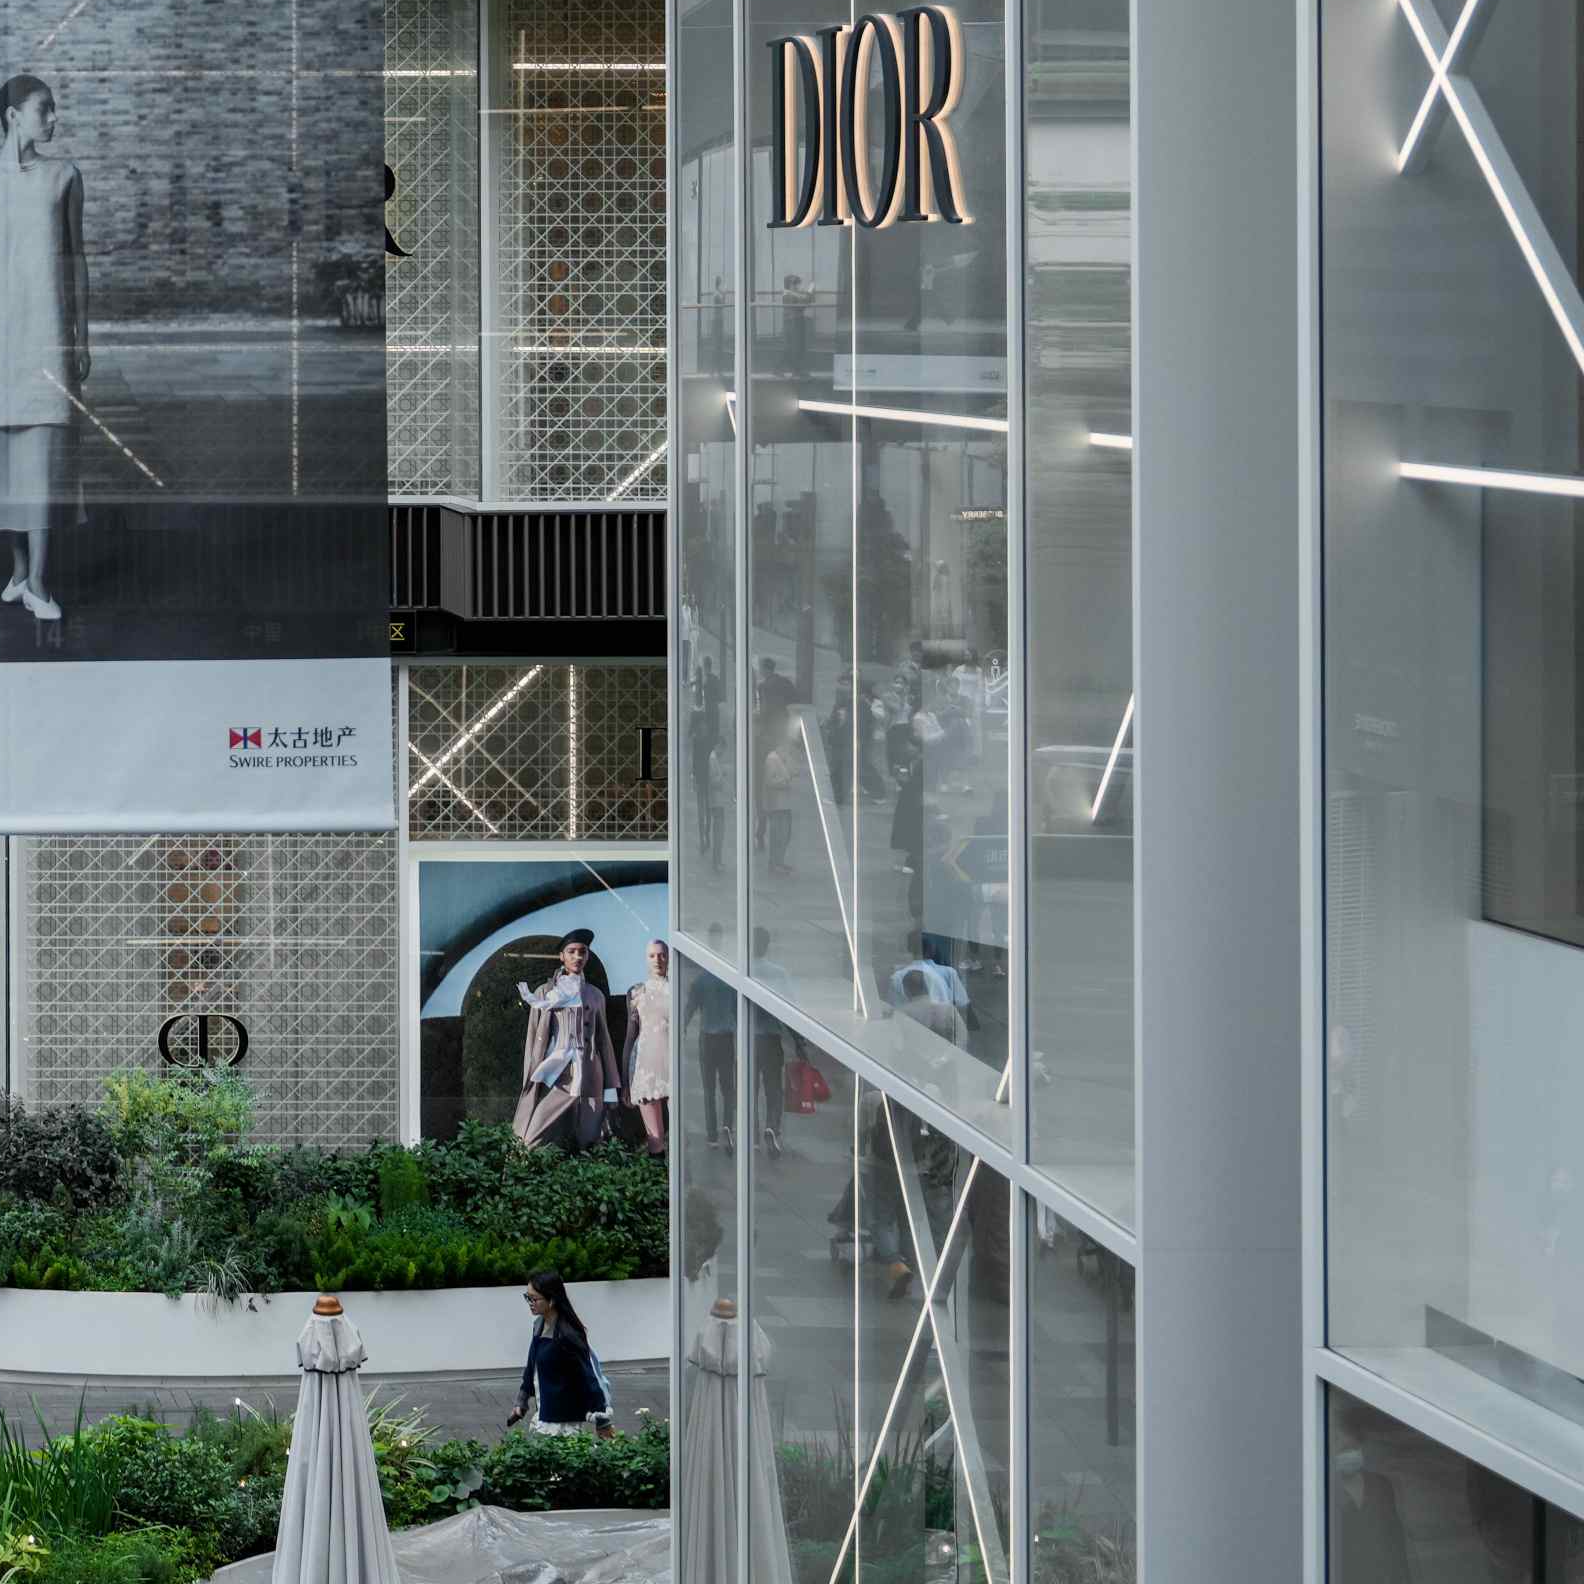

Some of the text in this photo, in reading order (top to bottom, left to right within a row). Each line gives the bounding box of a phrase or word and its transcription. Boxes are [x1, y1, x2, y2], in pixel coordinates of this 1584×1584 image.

[767, 4, 969, 228] DIOR
[267, 726, 357, 749] 太古地产
[229, 754, 358, 768] SWIRE PROPERTIES
